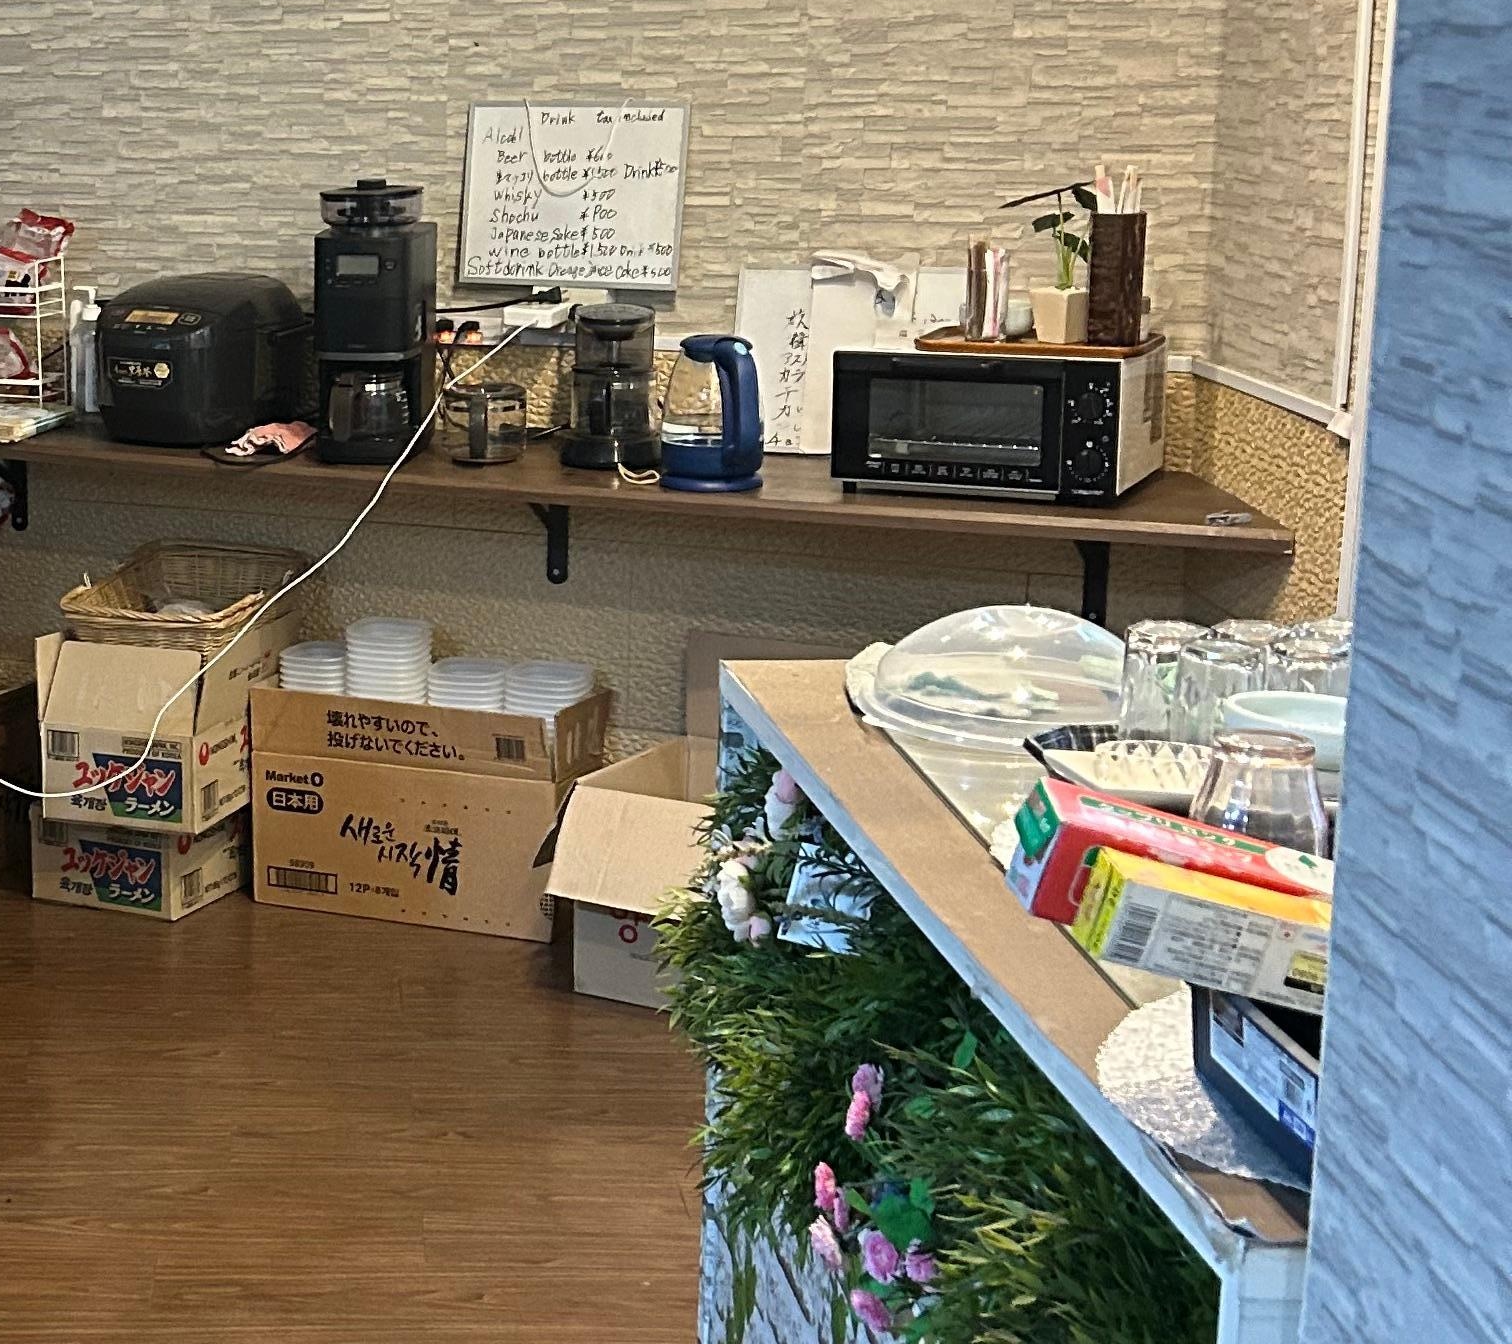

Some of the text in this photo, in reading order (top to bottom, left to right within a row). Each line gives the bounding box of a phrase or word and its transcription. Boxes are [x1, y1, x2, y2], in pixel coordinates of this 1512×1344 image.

[497, 150, 528, 164] Beer
[543, 165, 578, 182] bottle
[326, 709, 439, 738] 壊れやすいので、
[327, 732, 465, 761] 投げないでください。
[124, 796, 175, 817] ラーメン
[271, 791, 320, 812] 日本用
[339, 813, 396, 845] 새로운
[108, 884, 156, 904] ラーメン
